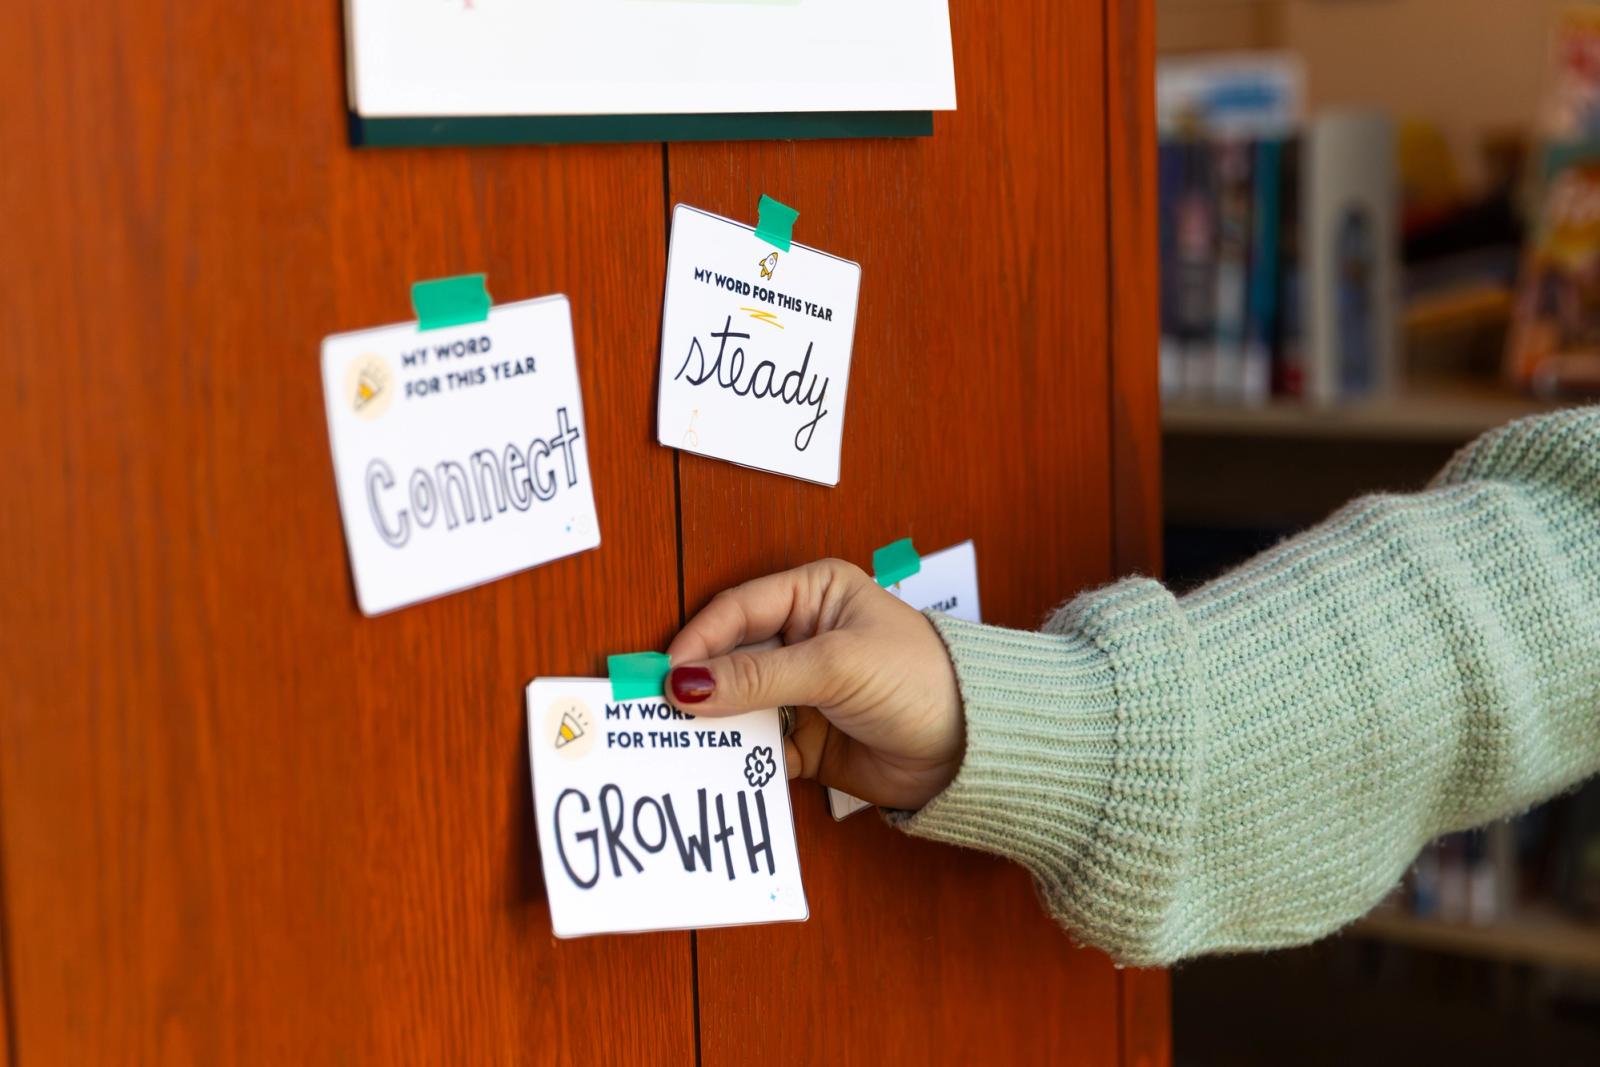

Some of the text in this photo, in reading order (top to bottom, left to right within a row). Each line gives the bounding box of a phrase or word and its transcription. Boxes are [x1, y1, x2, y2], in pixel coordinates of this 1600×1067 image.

[694, 267, 832, 322] MY WORD FOR THIS YEAR
[401, 336, 491, 368] MY WORD
[405, 356, 536, 399] FOR THIS YEAR
[674, 315, 829, 451] steady
[365, 407, 580, 550] Connect
[605, 703, 633, 720] MY
[607, 731, 742, 748] FOR THIS YEAR
